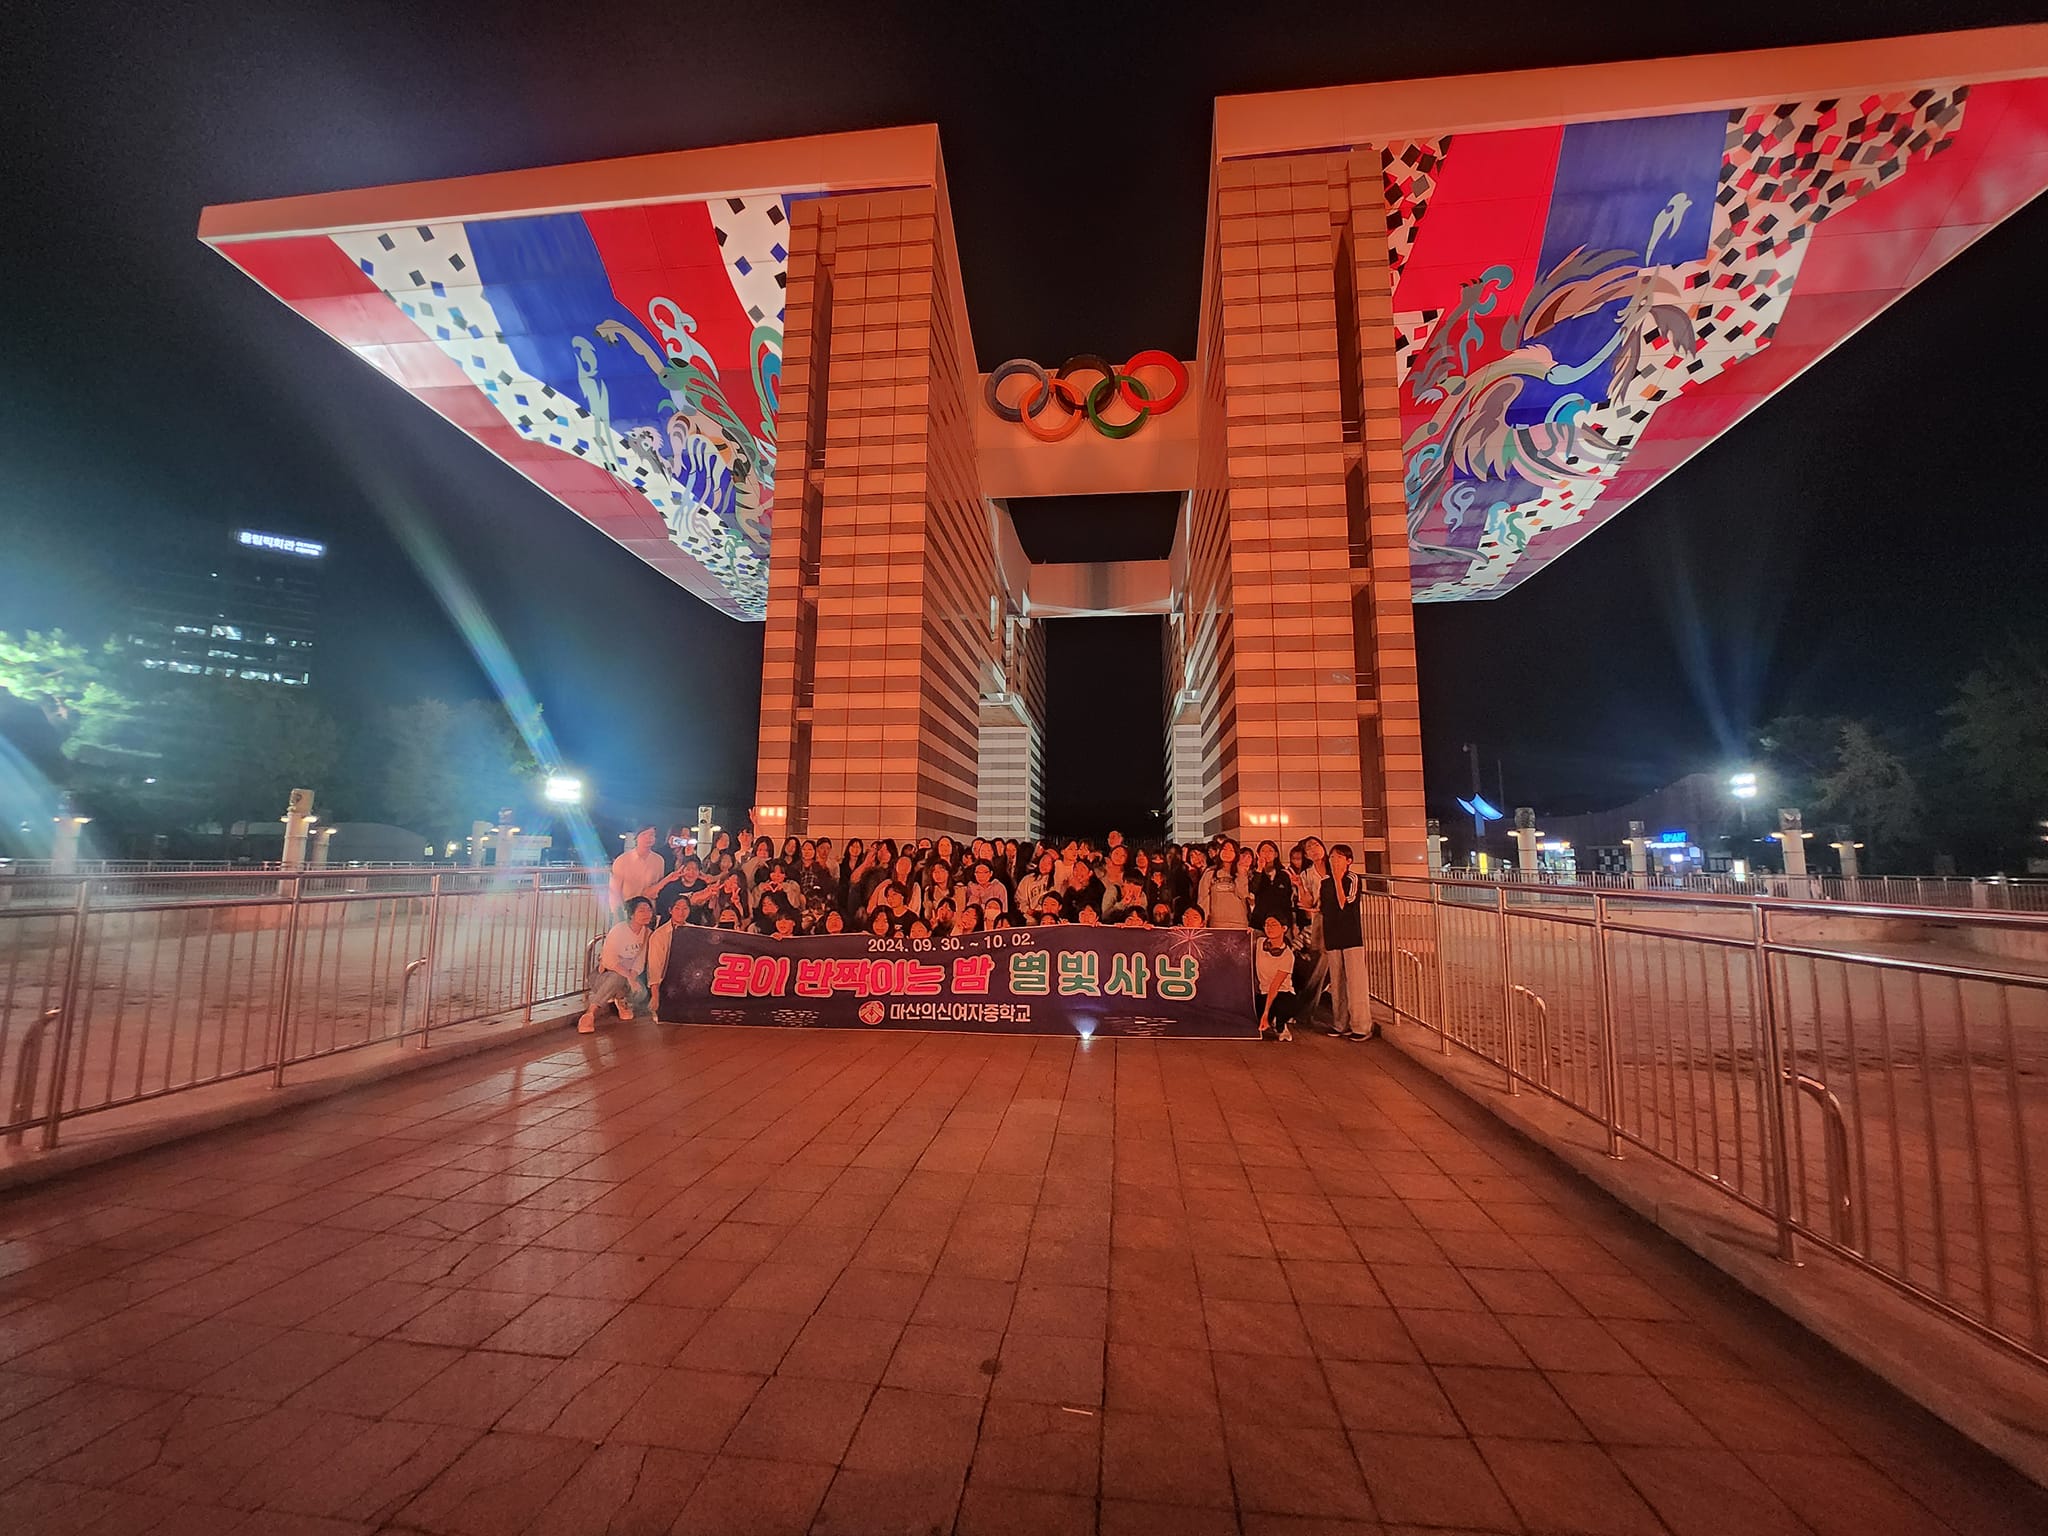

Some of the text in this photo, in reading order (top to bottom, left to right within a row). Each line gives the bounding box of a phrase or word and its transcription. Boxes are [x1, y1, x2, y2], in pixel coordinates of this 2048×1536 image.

[868, 938, 908, 952] 2024.
[913, 938, 936, 951] 09.
[941, 937, 964, 950] 30.
[984, 935, 1006, 948] 10.
[1012, 933, 1035, 946] 02.
[711, 953, 790, 997] 꿈이
[795, 958, 945, 998] 반짝이는
[951, 954, 995, 994] 밤
[890, 1003, 1031, 1022] 마산의신여자중학교
